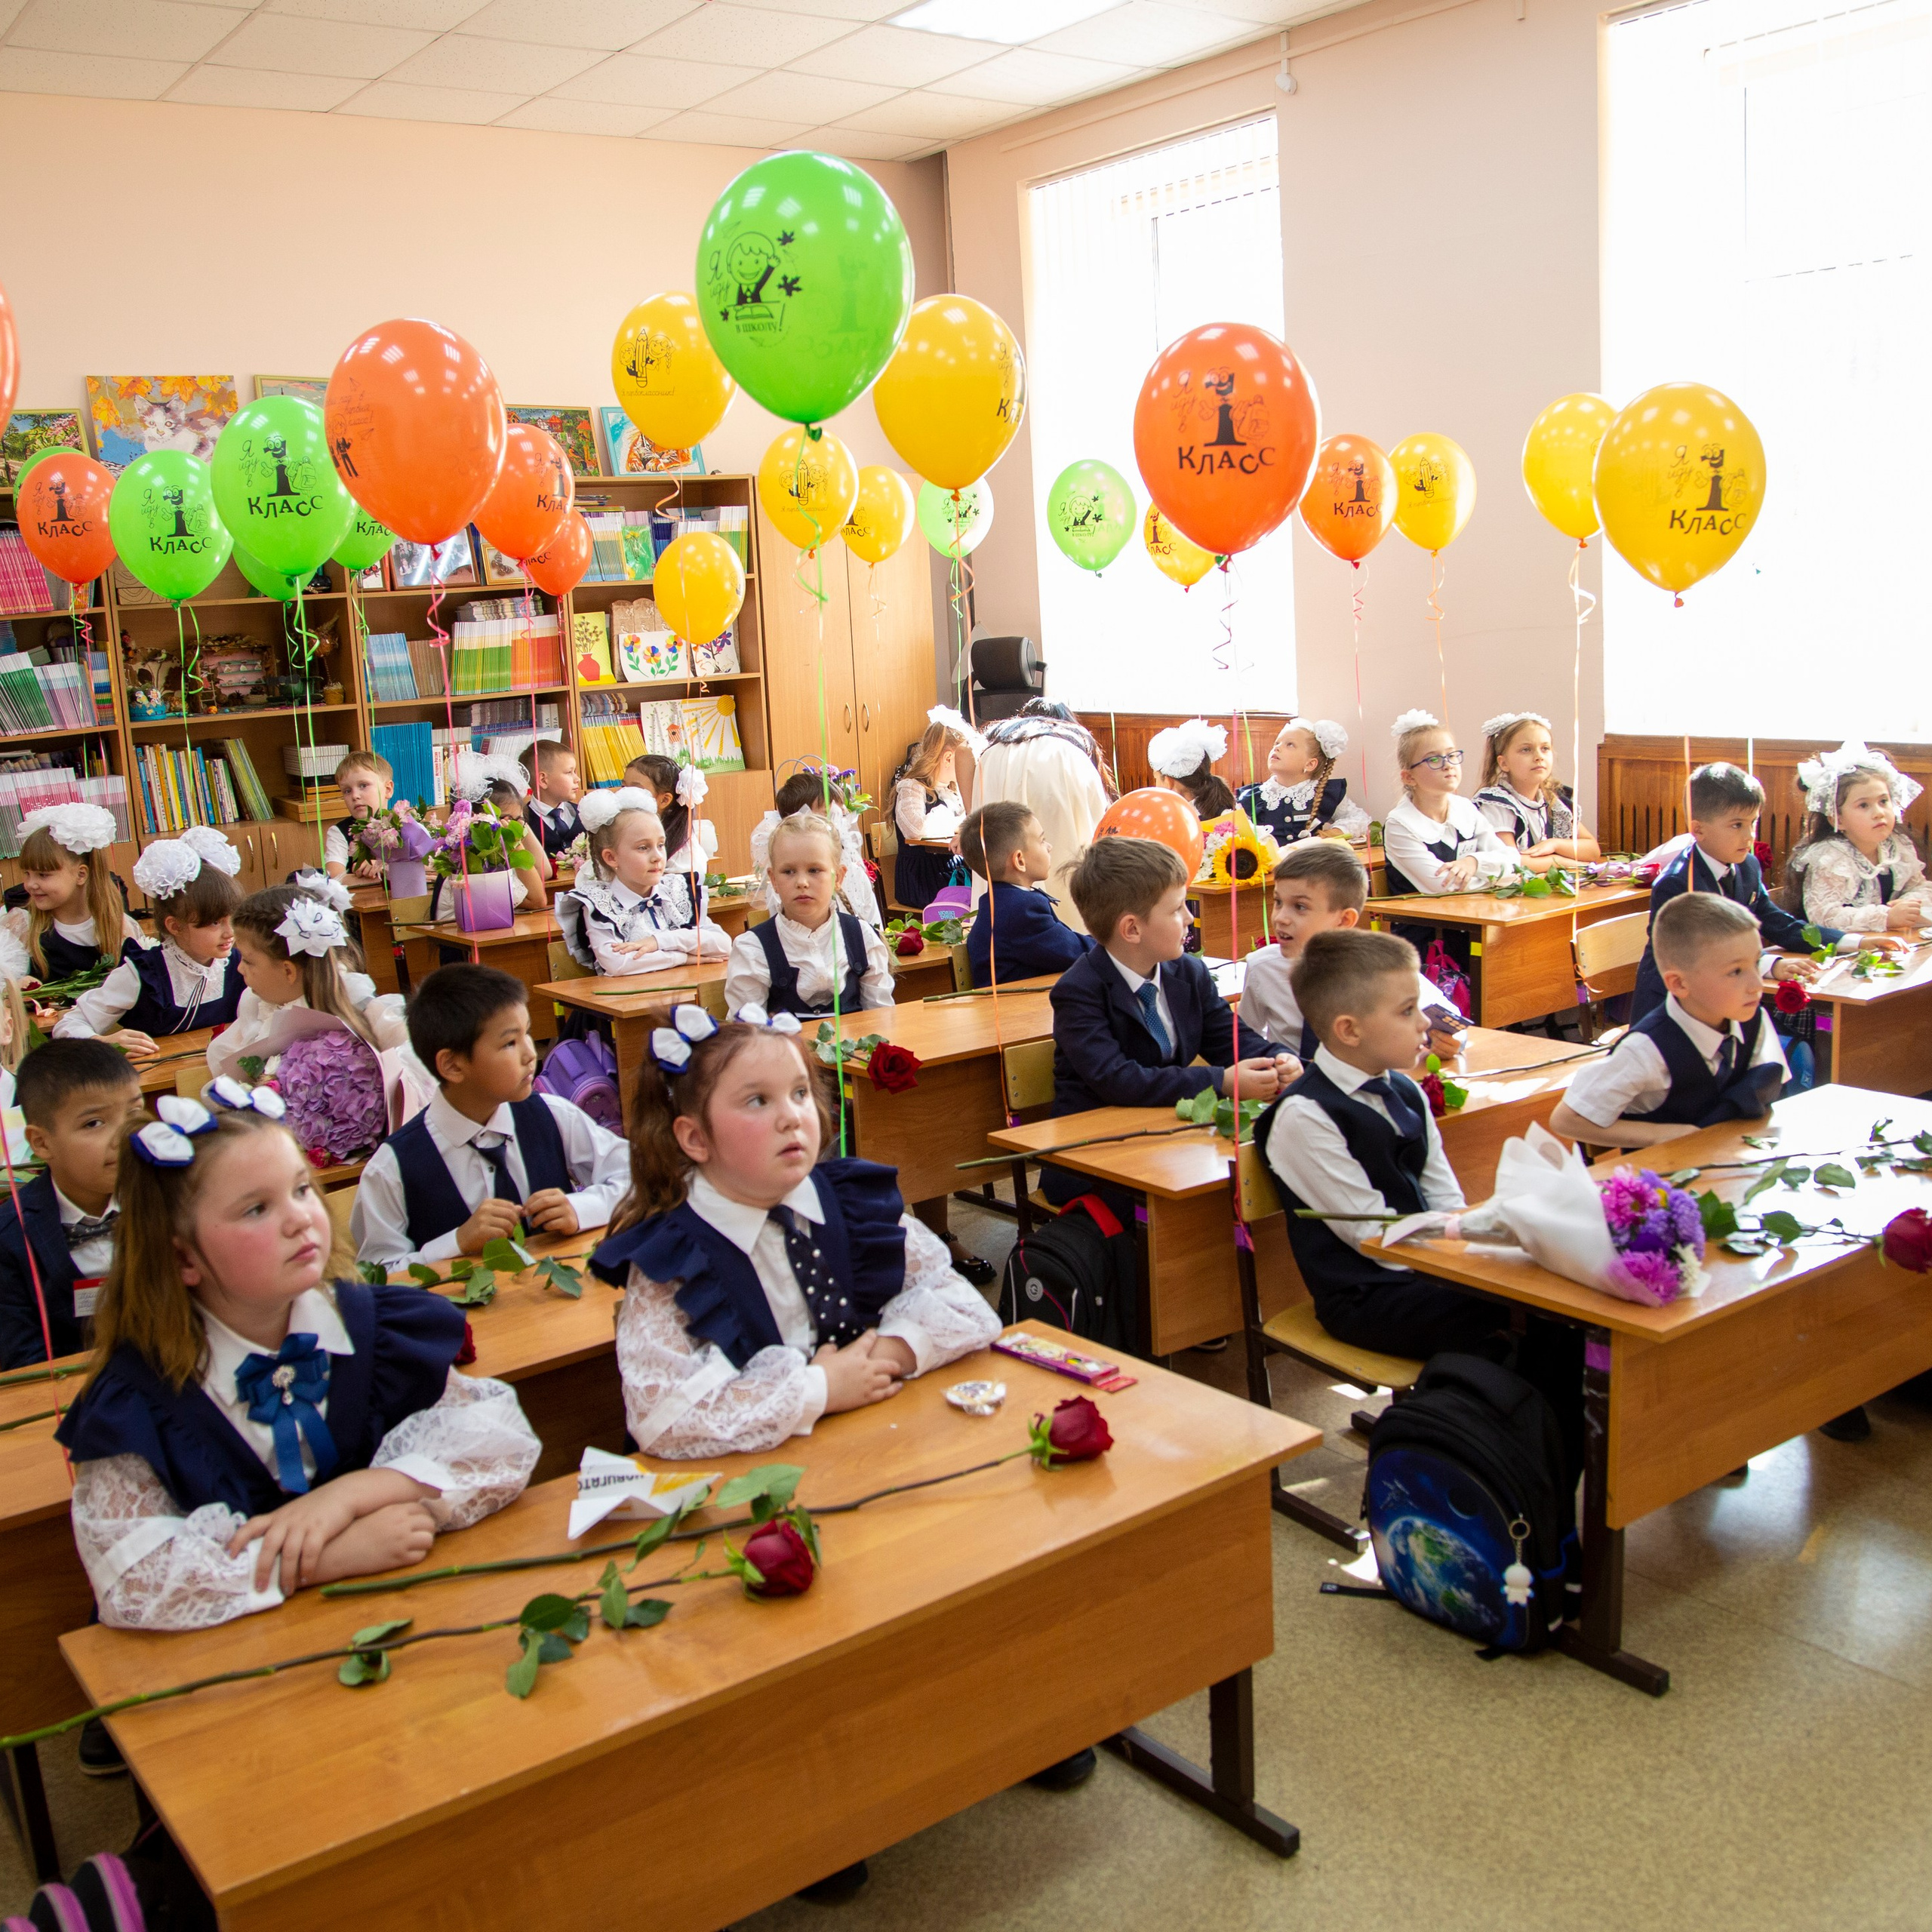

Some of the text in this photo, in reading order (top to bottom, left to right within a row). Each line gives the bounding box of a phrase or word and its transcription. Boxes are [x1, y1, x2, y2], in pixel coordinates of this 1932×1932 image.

[706, 250, 723, 285] Я
[998, 342, 1010, 361] Я
[1173, 371, 1193, 398] Я
[996, 398, 1022, 424] КЛА
[238, 439, 254, 461] Я
[1670, 445, 1690, 468] Я
[238, 458, 260, 476] иду
[534, 453, 545, 468] Я
[1178, 445, 1276, 475] КЛАСС
[1330, 462, 1341, 477] Я
[33, 481, 44, 497] Я
[246, 474, 253, 488] в
[141, 488, 155, 506] Я
[537, 494, 571, 515] КЛАС
[141, 504, 160, 518] иду
[248, 495, 324, 518] КЛАСС
[1058, 502, 1068, 516] Я
[38, 521, 93, 538] КЛАСС
[149, 517, 155, 529] в
[356, 521, 392, 536] КЛАС
[1669, 509, 1747, 536] КЛАСС
[149, 537, 213, 555] КЛАСС
[524, 552, 552, 567] ЛАСС
